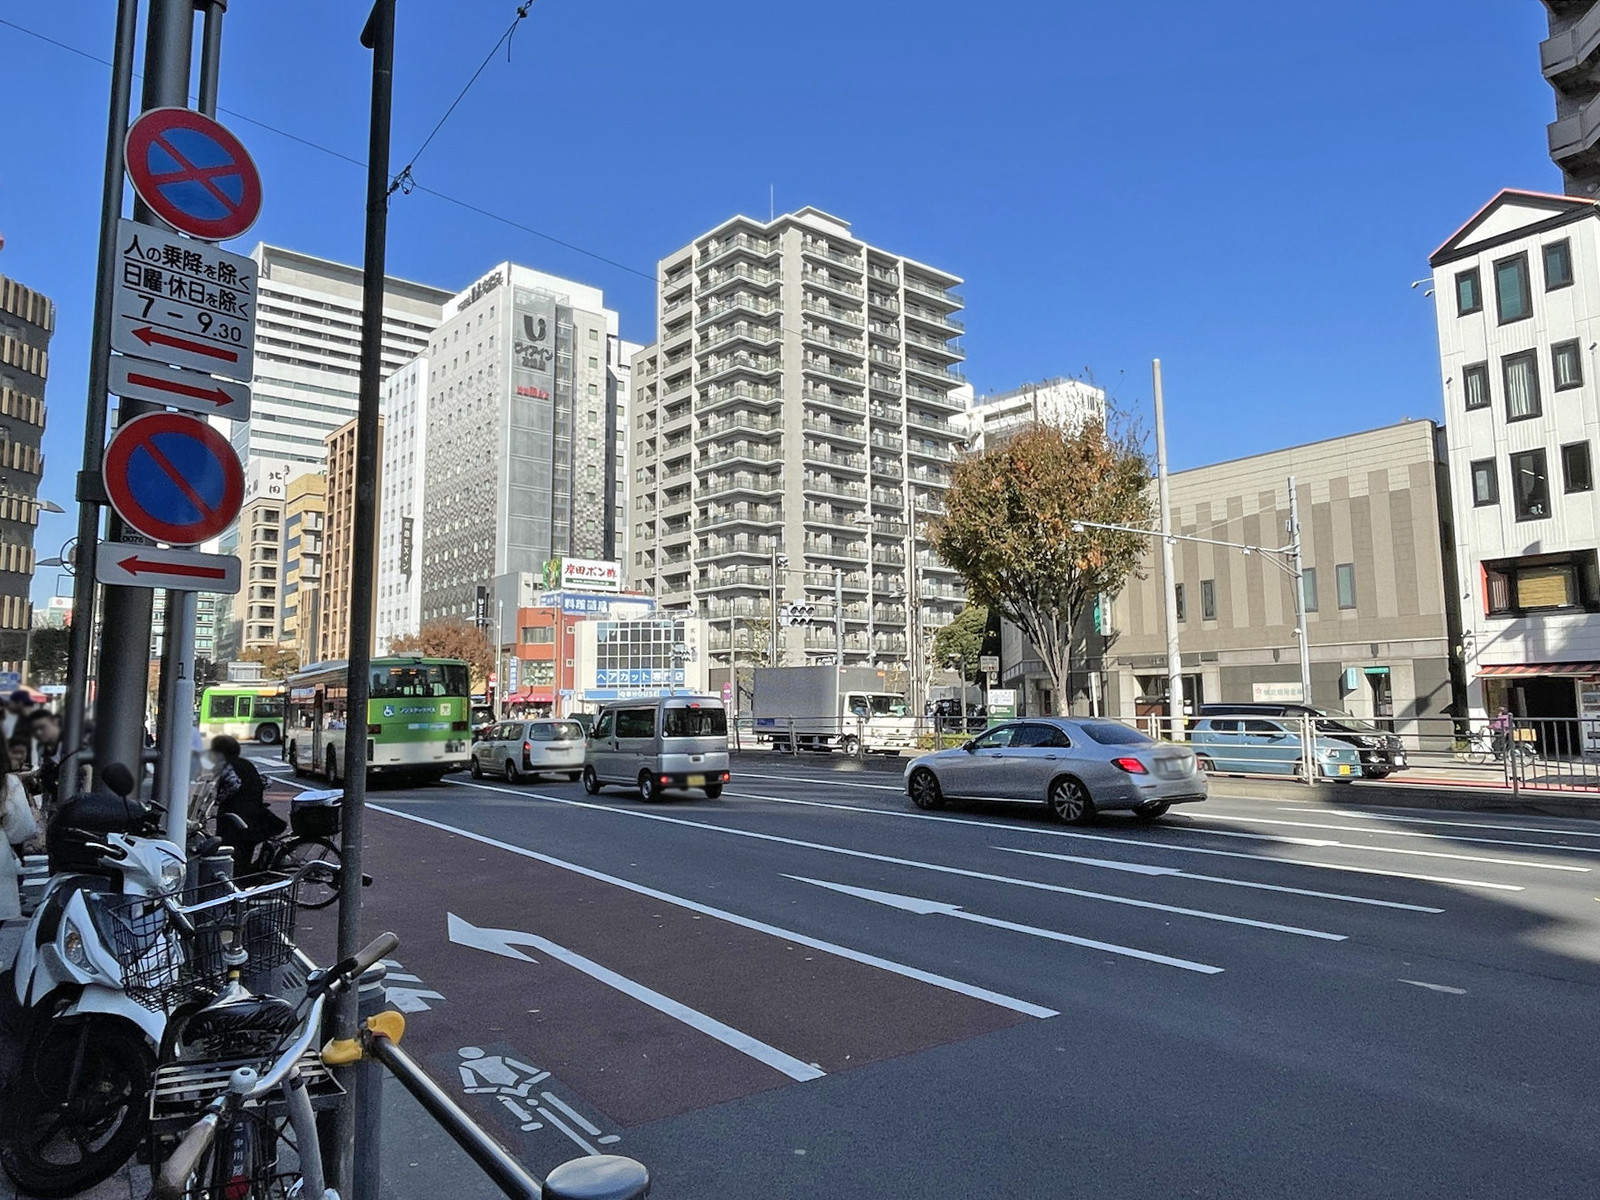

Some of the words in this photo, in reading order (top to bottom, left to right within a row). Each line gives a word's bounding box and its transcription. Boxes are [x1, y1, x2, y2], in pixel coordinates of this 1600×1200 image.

[123, 234, 250, 291] 人の乗降を除く
[124, 261, 249, 318] 日曜・休日を除く
[197, 312, 242, 342] 9.30
[597, 671, 684, 682] ヘアカット専門店
